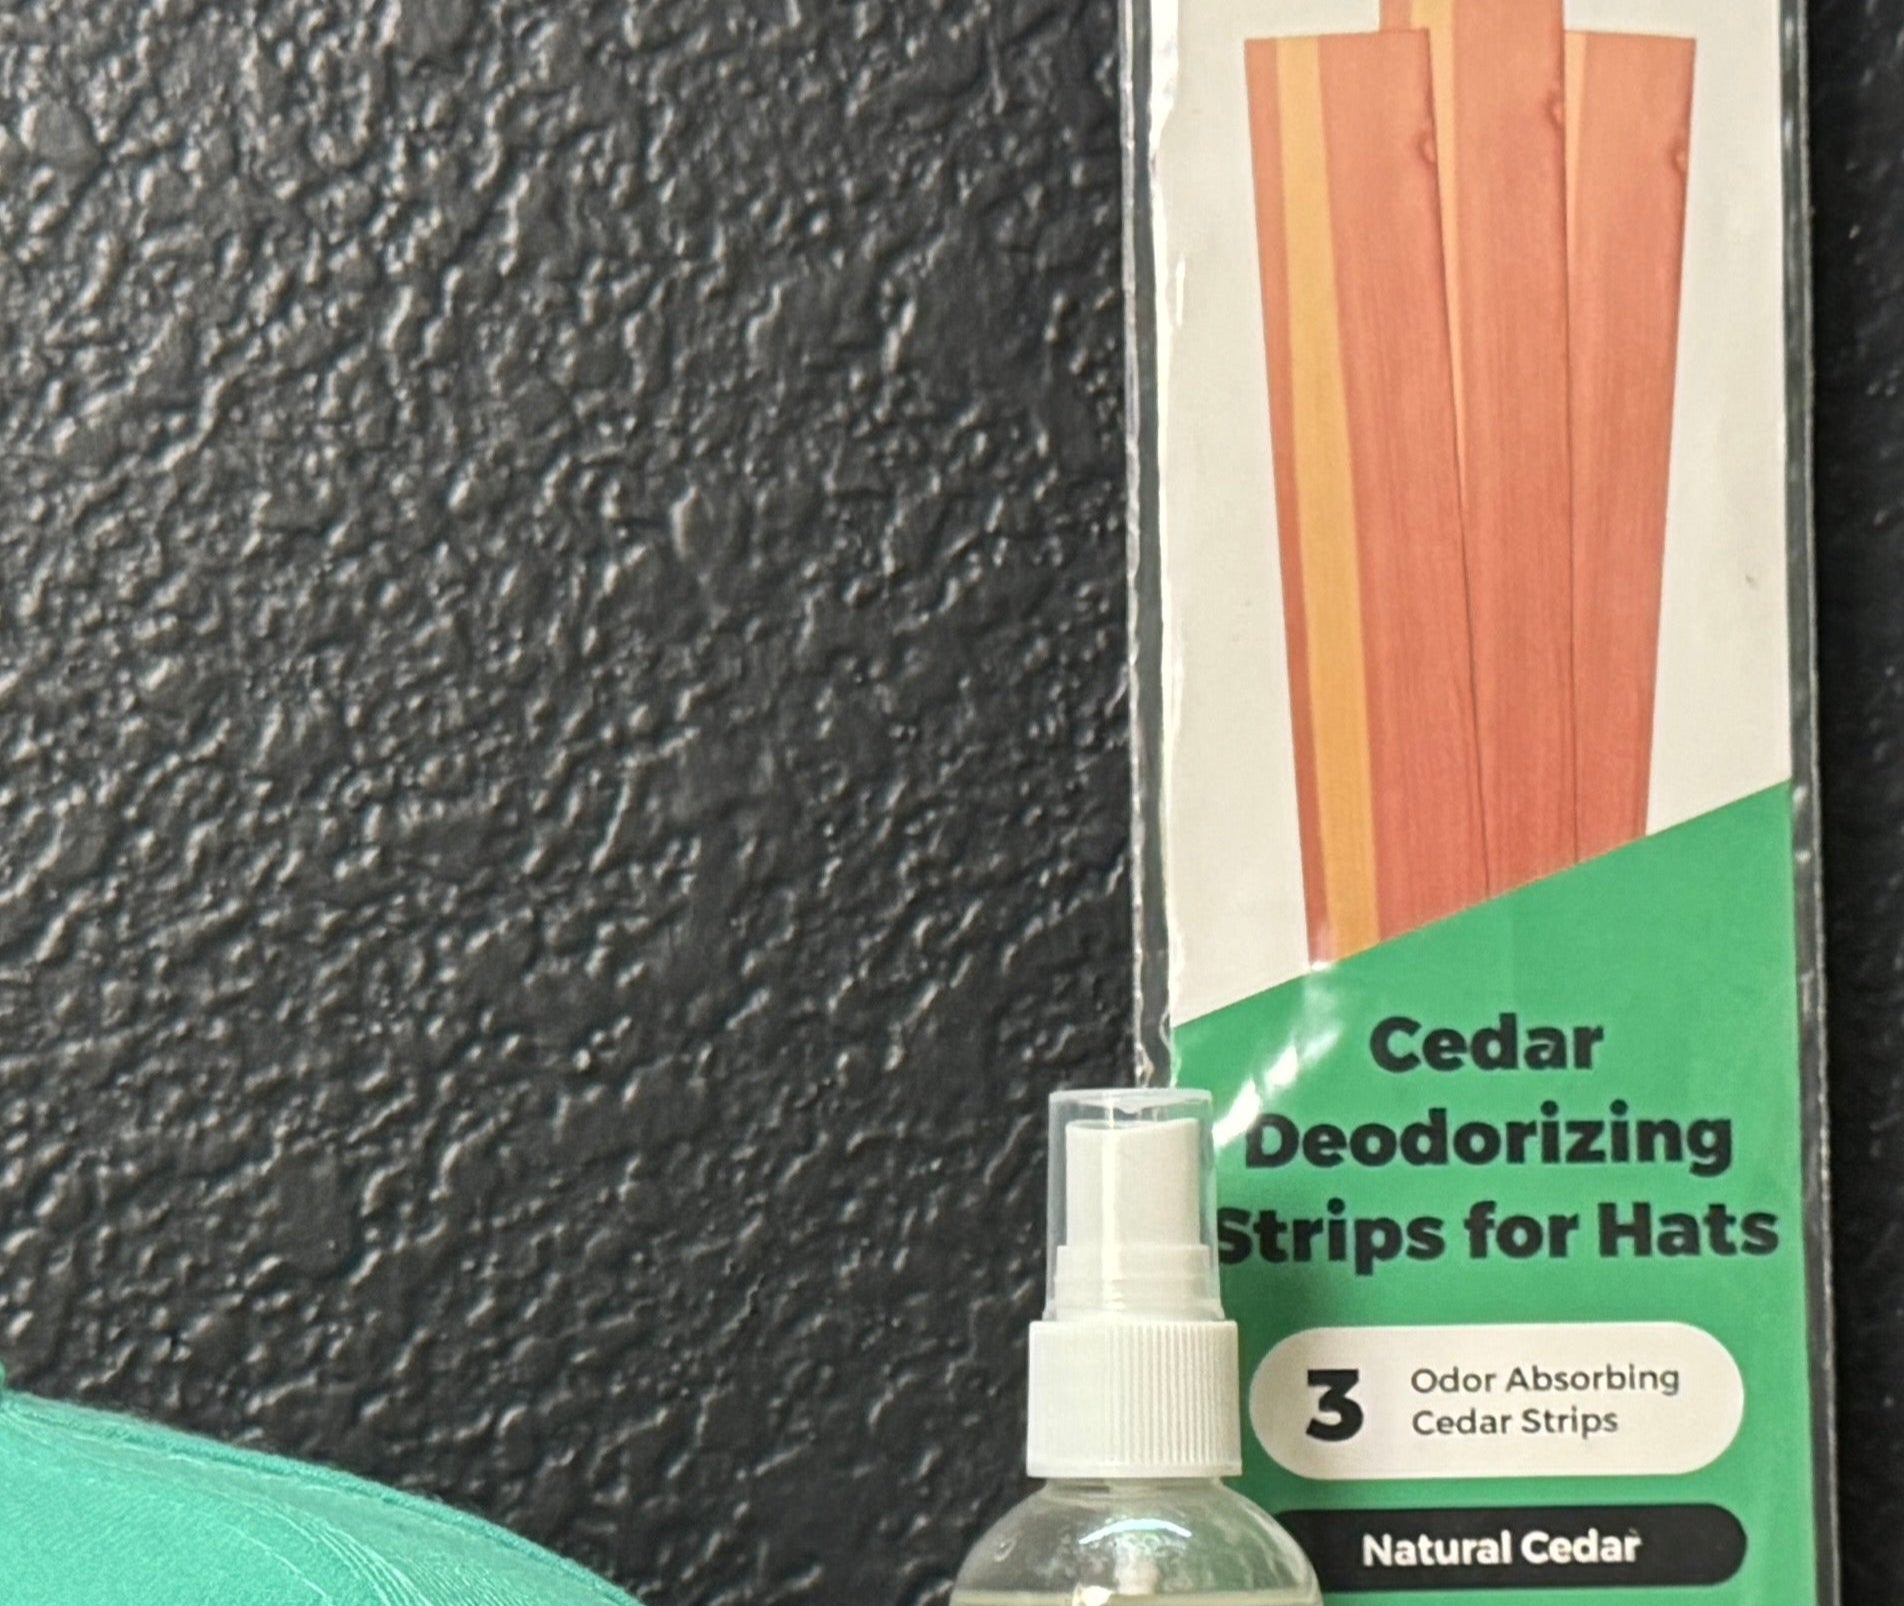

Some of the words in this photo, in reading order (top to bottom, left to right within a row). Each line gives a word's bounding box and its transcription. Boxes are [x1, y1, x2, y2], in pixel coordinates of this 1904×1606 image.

[1370, 1012, 1604, 1073] Cedar
[1245, 1100, 1733, 1176] Deodorizing
[1215, 1198, 1444, 1276] Strips
[1465, 1201, 1579, 1258] for
[1598, 1202, 1779, 1257] Hats
[1305, 1369, 1364, 1442] 3
[1410, 1367, 1496, 1395] Odor
[1505, 1364, 1681, 1396] Absorbing
[1412, 1409, 1511, 1437] Cedar
[1521, 1407, 1618, 1439] Strips
[1363, 1532, 1512, 1569] Natural
[1521, 1529, 1641, 1563] Cedar
